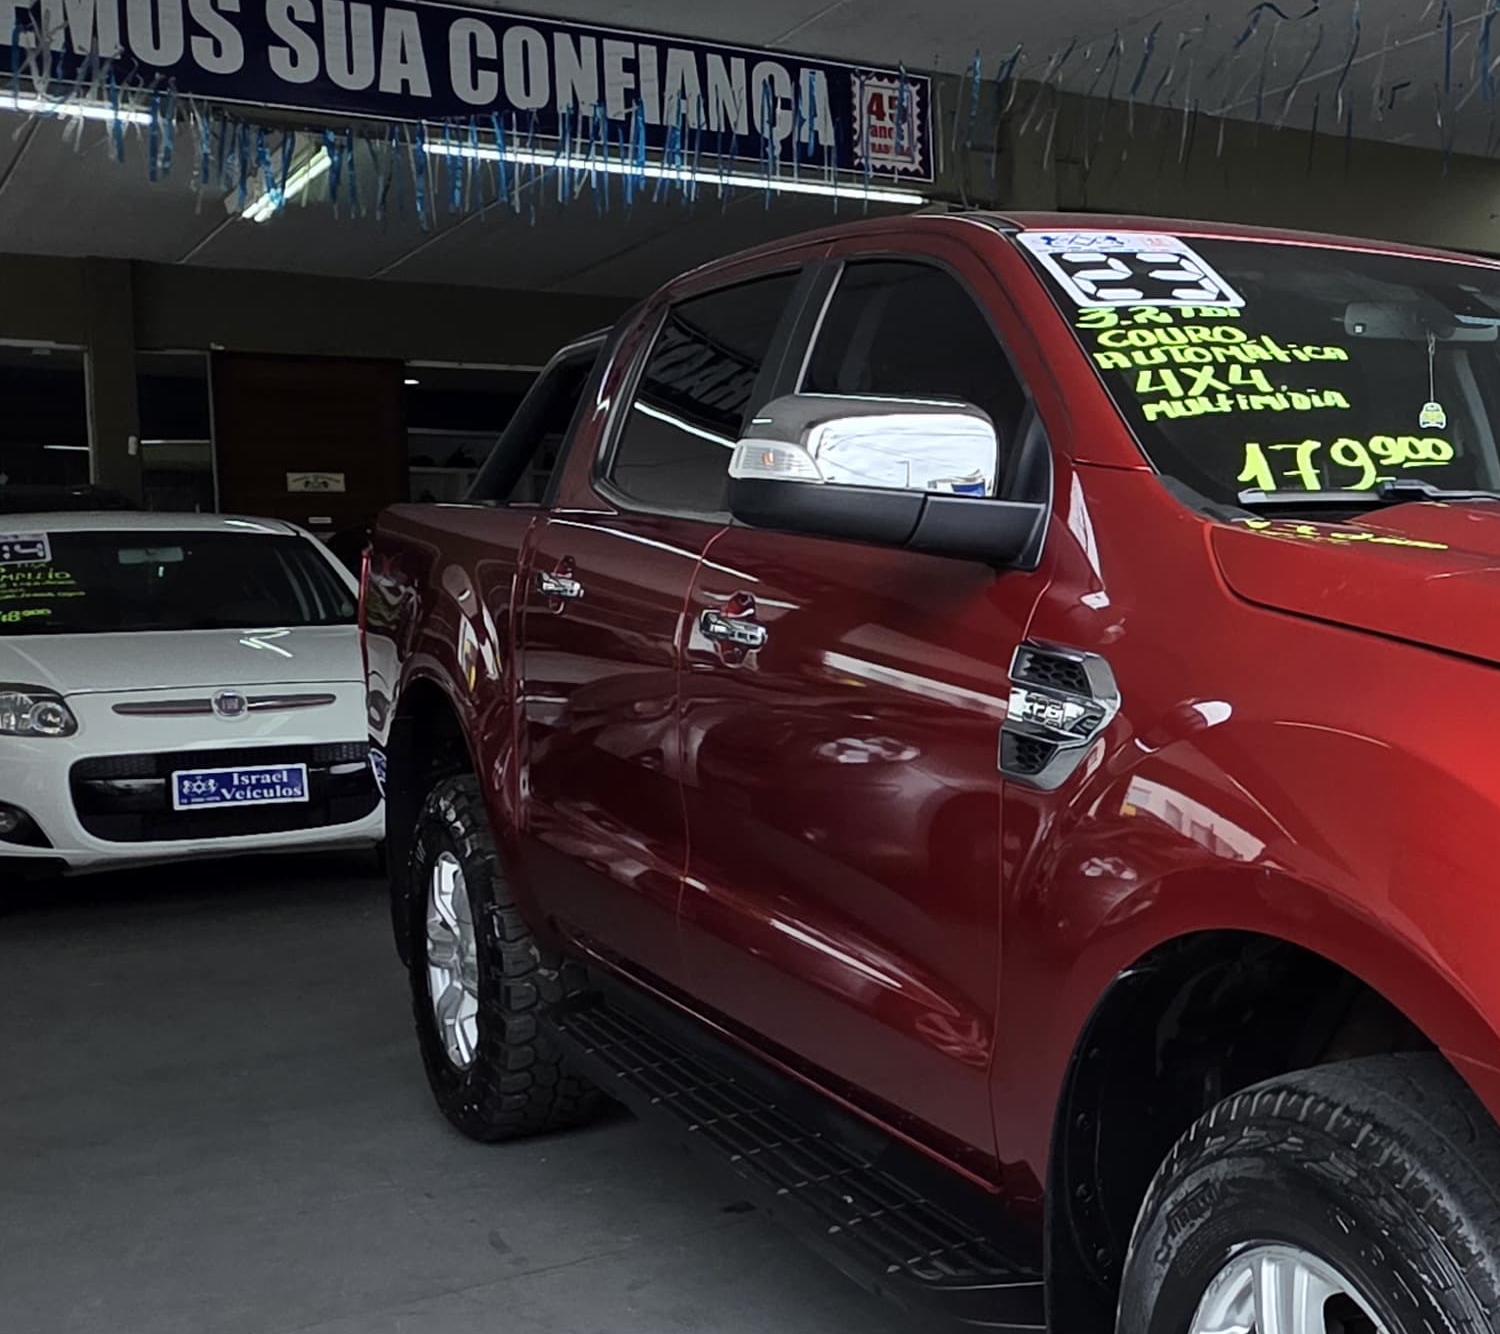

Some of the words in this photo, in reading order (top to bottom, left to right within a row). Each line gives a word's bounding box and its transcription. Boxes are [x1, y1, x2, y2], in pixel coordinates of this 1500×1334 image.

[1061, 252, 1220, 301] 23
[1075, 306, 1174, 329] 3.2
[1097, 326, 1248, 347] COURO
[233, 770, 288, 786] Israel
[220, 782, 302, 801] Veículos
